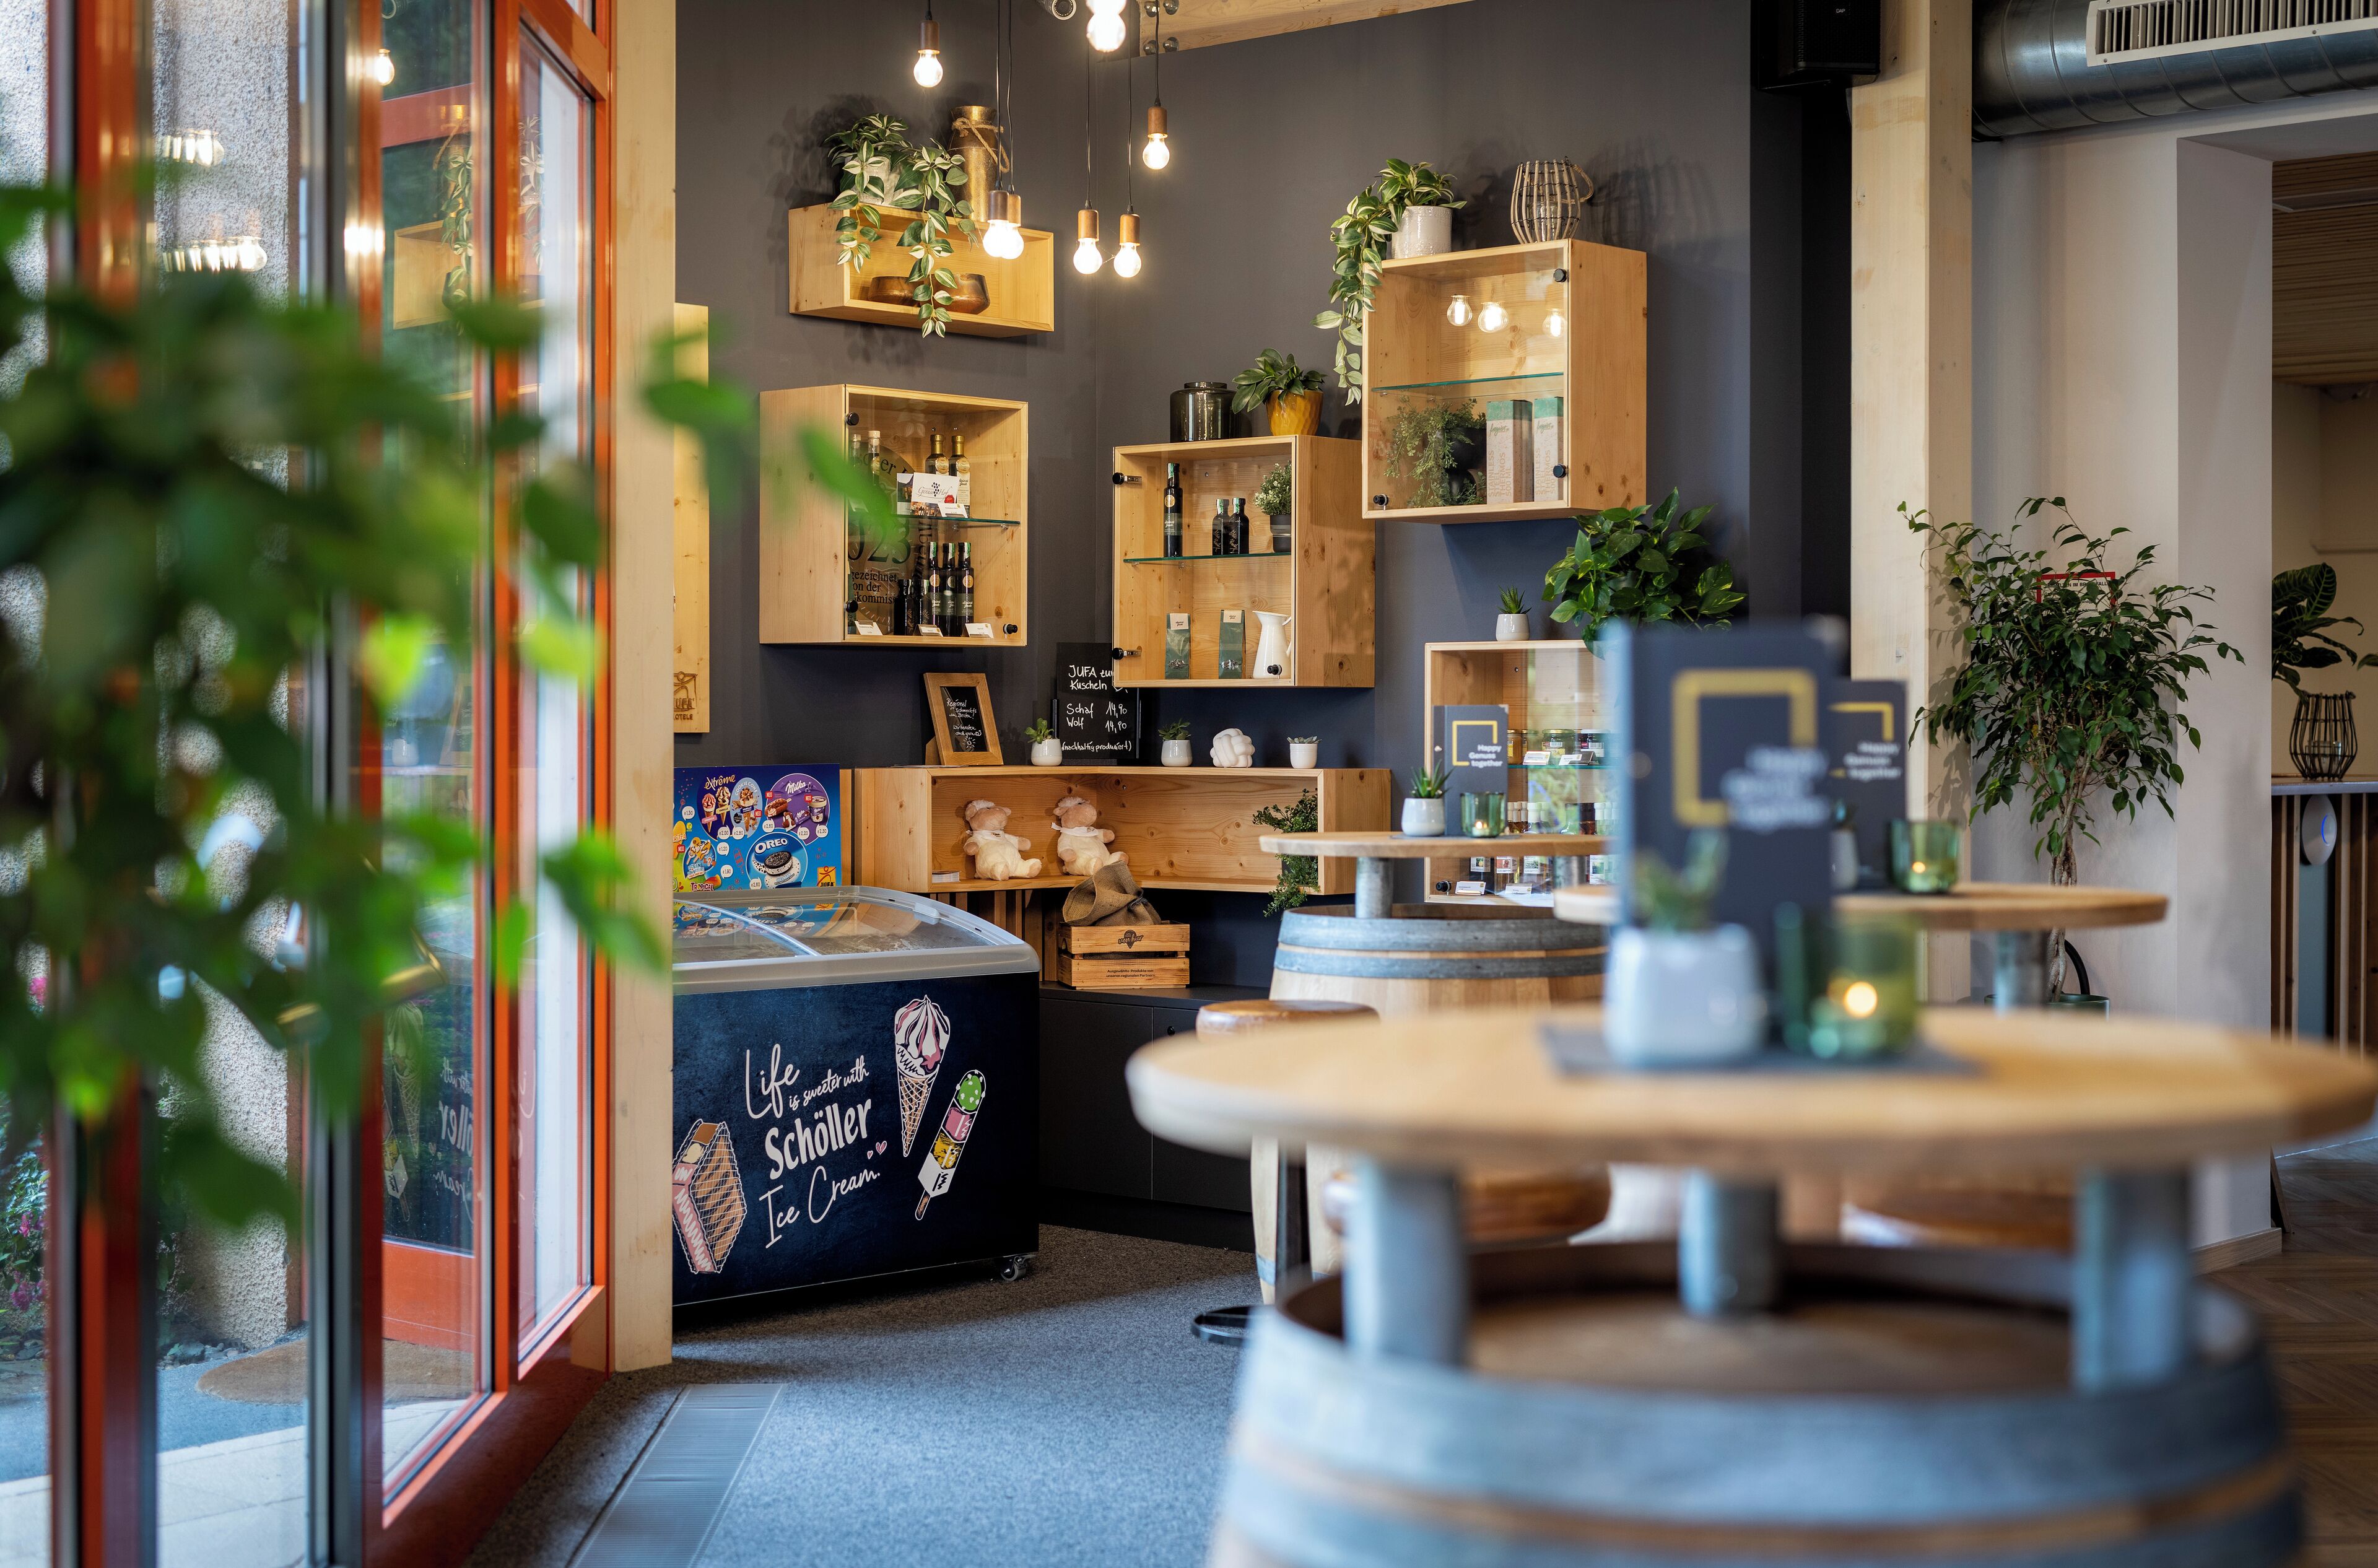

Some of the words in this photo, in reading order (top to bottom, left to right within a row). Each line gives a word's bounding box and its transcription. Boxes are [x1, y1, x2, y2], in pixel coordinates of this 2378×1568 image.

[853, 582, 863, 591] on
[866, 581, 881, 592] der
[1068, 664, 1097, 678] JUFA
[1069, 679, 1107, 690] Kuscheln
[946, 698, 967, 710] Regional
[1066, 703, 1094, 719] Schaf
[1105, 701, 1128, 718] 14,90
[1066, 716, 1084, 730] Wolf
[1477, 744, 1502, 753] Happy
[1471, 759, 1504, 769] together
[785, 780, 807, 794] Milka
[755, 838, 788, 854] OREO
[746, 1043, 800, 1118] Life
[789, 1094, 799, 1111] is
[803, 1069, 842, 1107] sweeter
[843, 1055, 869, 1087] with
[765, 1099, 871, 1180] Schöller
[759, 1185, 800, 1248] Ice
[808, 1165, 881, 1224] Cream.
